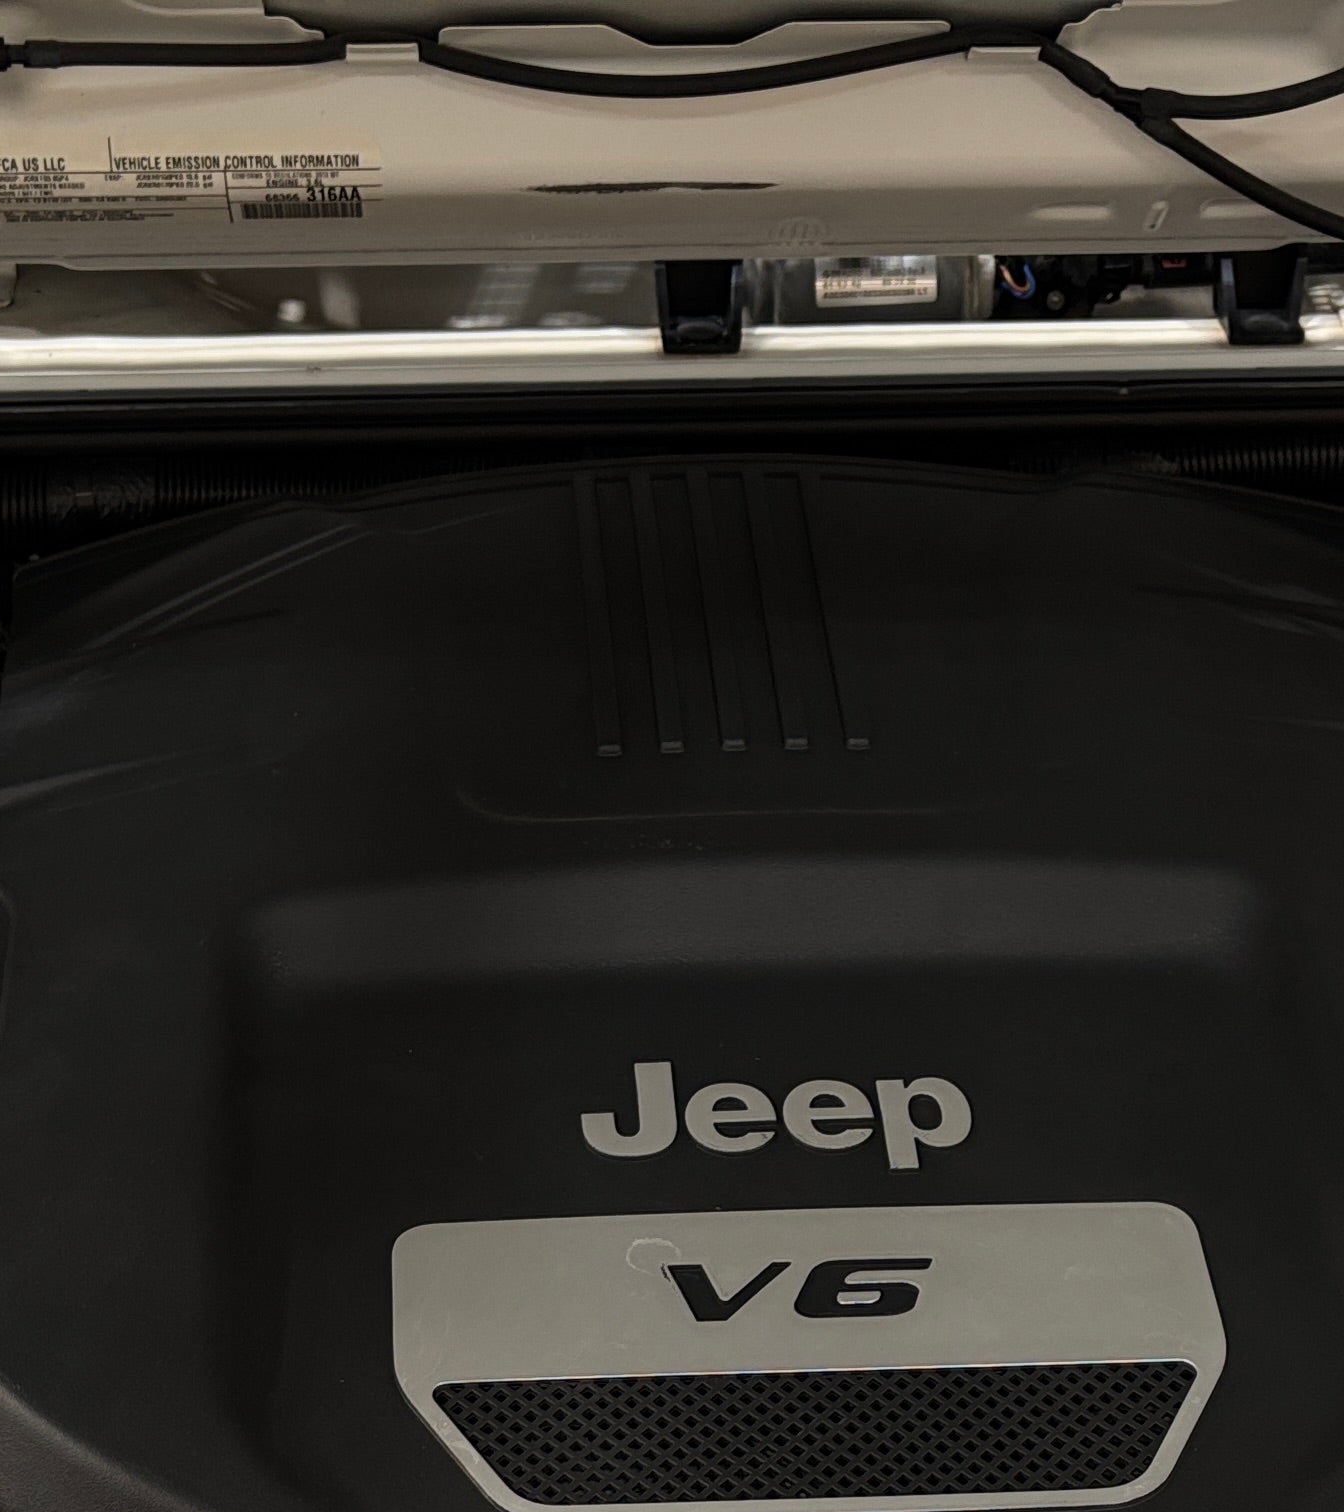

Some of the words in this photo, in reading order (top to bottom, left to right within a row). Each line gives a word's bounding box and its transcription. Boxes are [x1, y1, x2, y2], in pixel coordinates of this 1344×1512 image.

[22, 158, 39, 171] US
[44, 158, 66, 171] LLC
[114, 157, 161, 170] VEHICLE
[165, 156, 220, 170] EMISSION
[224, 155, 277, 169] CONTROL
[281, 154, 360, 168] INFORMATION
[306, 187, 361, 202] 316AA
[581, 1061, 972, 1169] Jeep
[666, 1257, 933, 1322] V6
